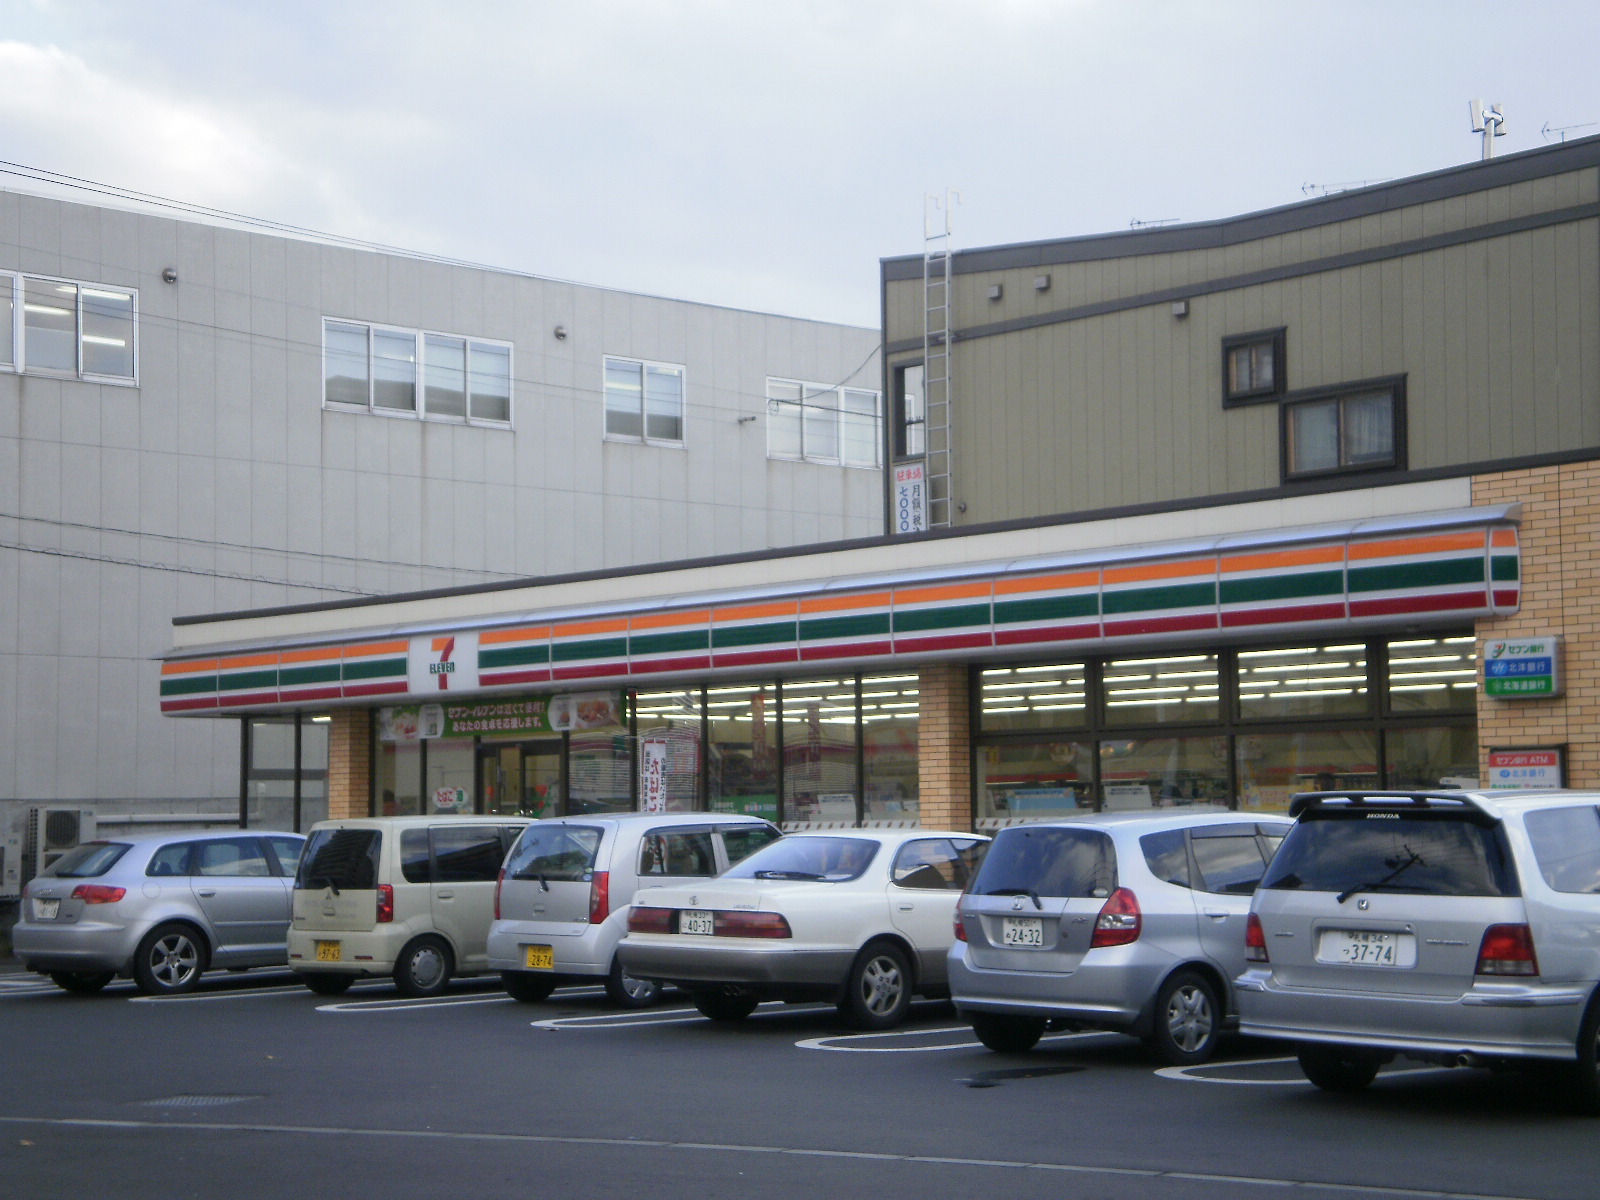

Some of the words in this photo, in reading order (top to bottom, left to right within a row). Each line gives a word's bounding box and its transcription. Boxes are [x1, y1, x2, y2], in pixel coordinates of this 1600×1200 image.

[1509, 644, 1545, 654] セブン銀行
[1509, 661, 1545, 672] 北洋銀行
[1503, 680, 1546, 690] 北海道銀行
[1012, 928, 1041, 943] 24-32
[1350, 944, 1392, 961] 37-74
